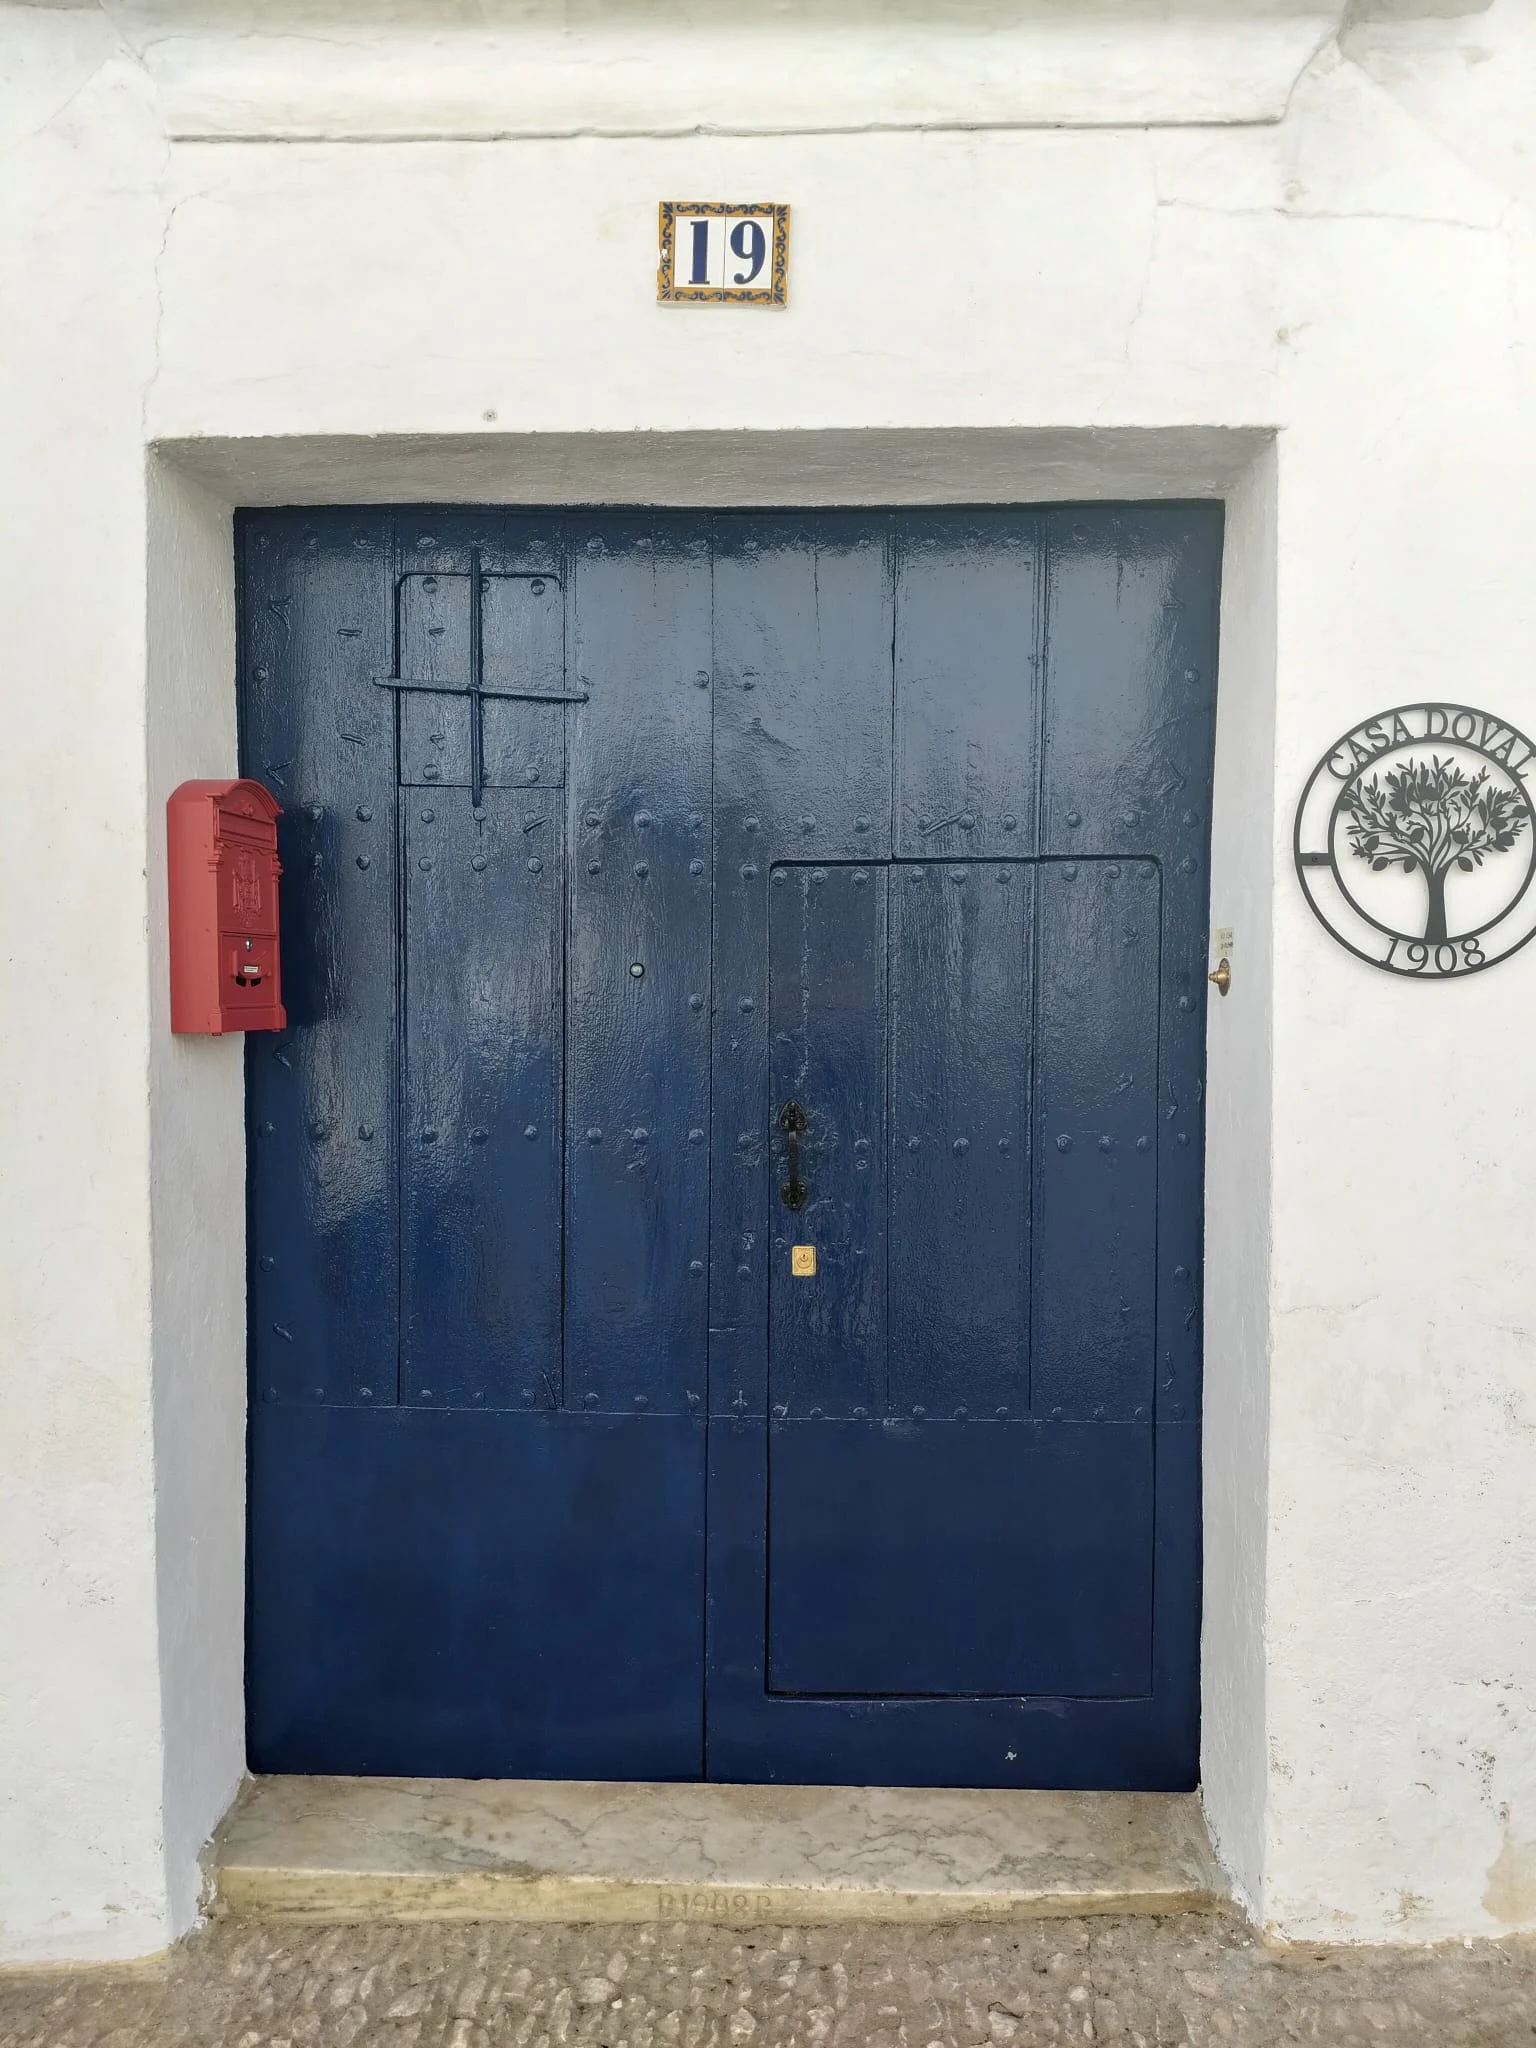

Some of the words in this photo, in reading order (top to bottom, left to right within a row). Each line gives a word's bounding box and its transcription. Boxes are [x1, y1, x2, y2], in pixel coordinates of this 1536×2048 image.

[688, 219, 766, 285] 19
[1327, 711, 1414, 780] CASA
[1424, 707, 1536, 780] DOVAL
[1380, 937, 1486, 973] 1908
